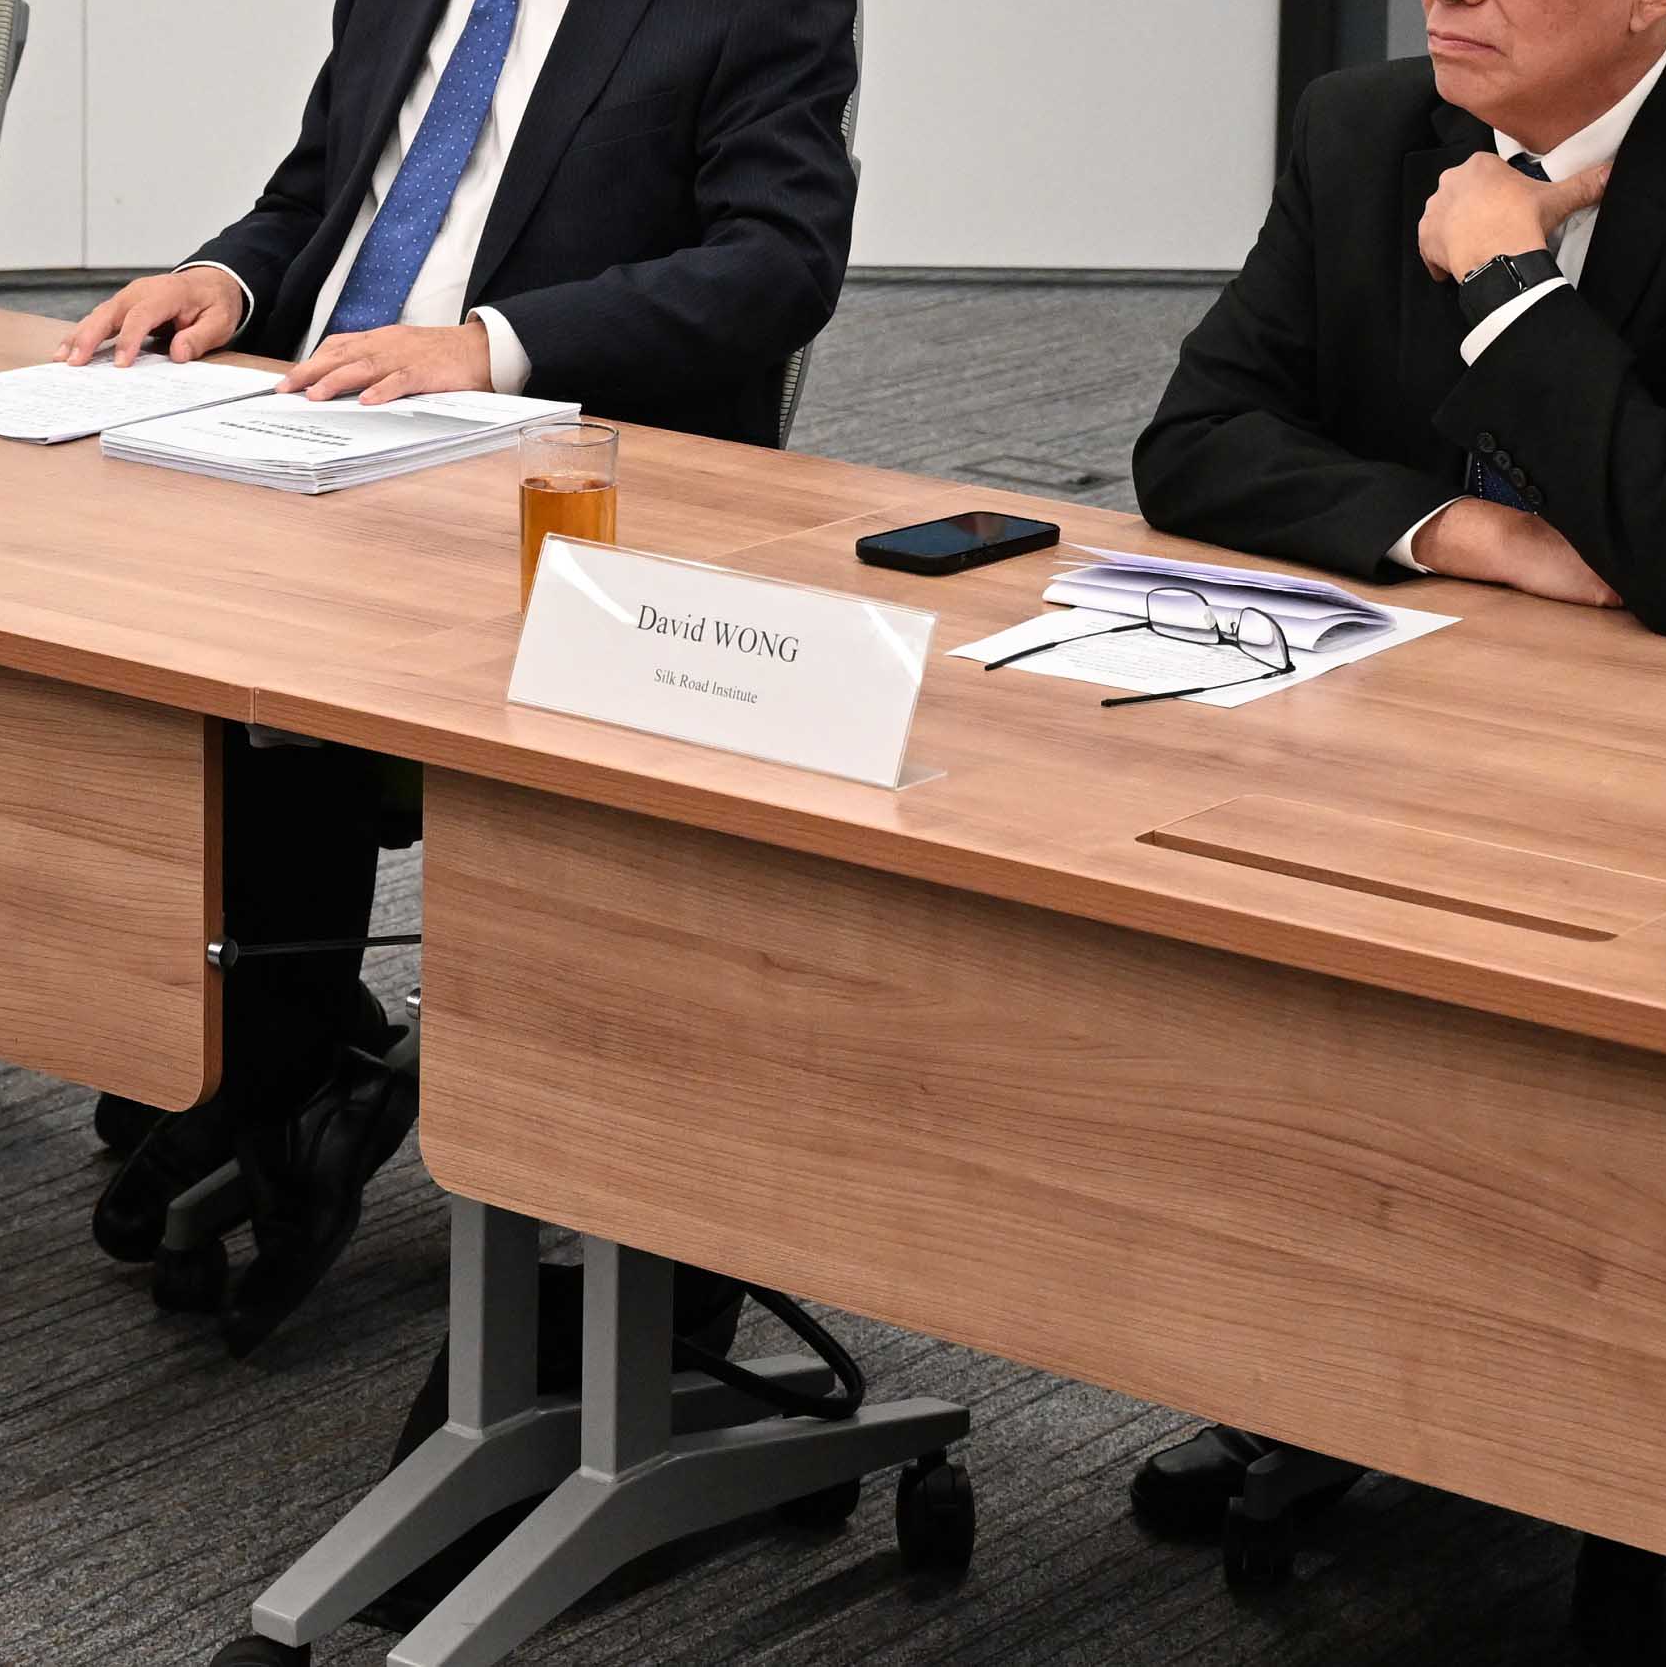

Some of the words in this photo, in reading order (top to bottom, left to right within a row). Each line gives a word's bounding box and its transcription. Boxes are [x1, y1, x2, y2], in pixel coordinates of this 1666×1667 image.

[636, 604, 705, 643] David
[713, 621, 800, 663] WONG
[654, 668, 676, 687] Silk
[679, 674, 709, 695] Road
[712, 681, 758, 705] Institute
